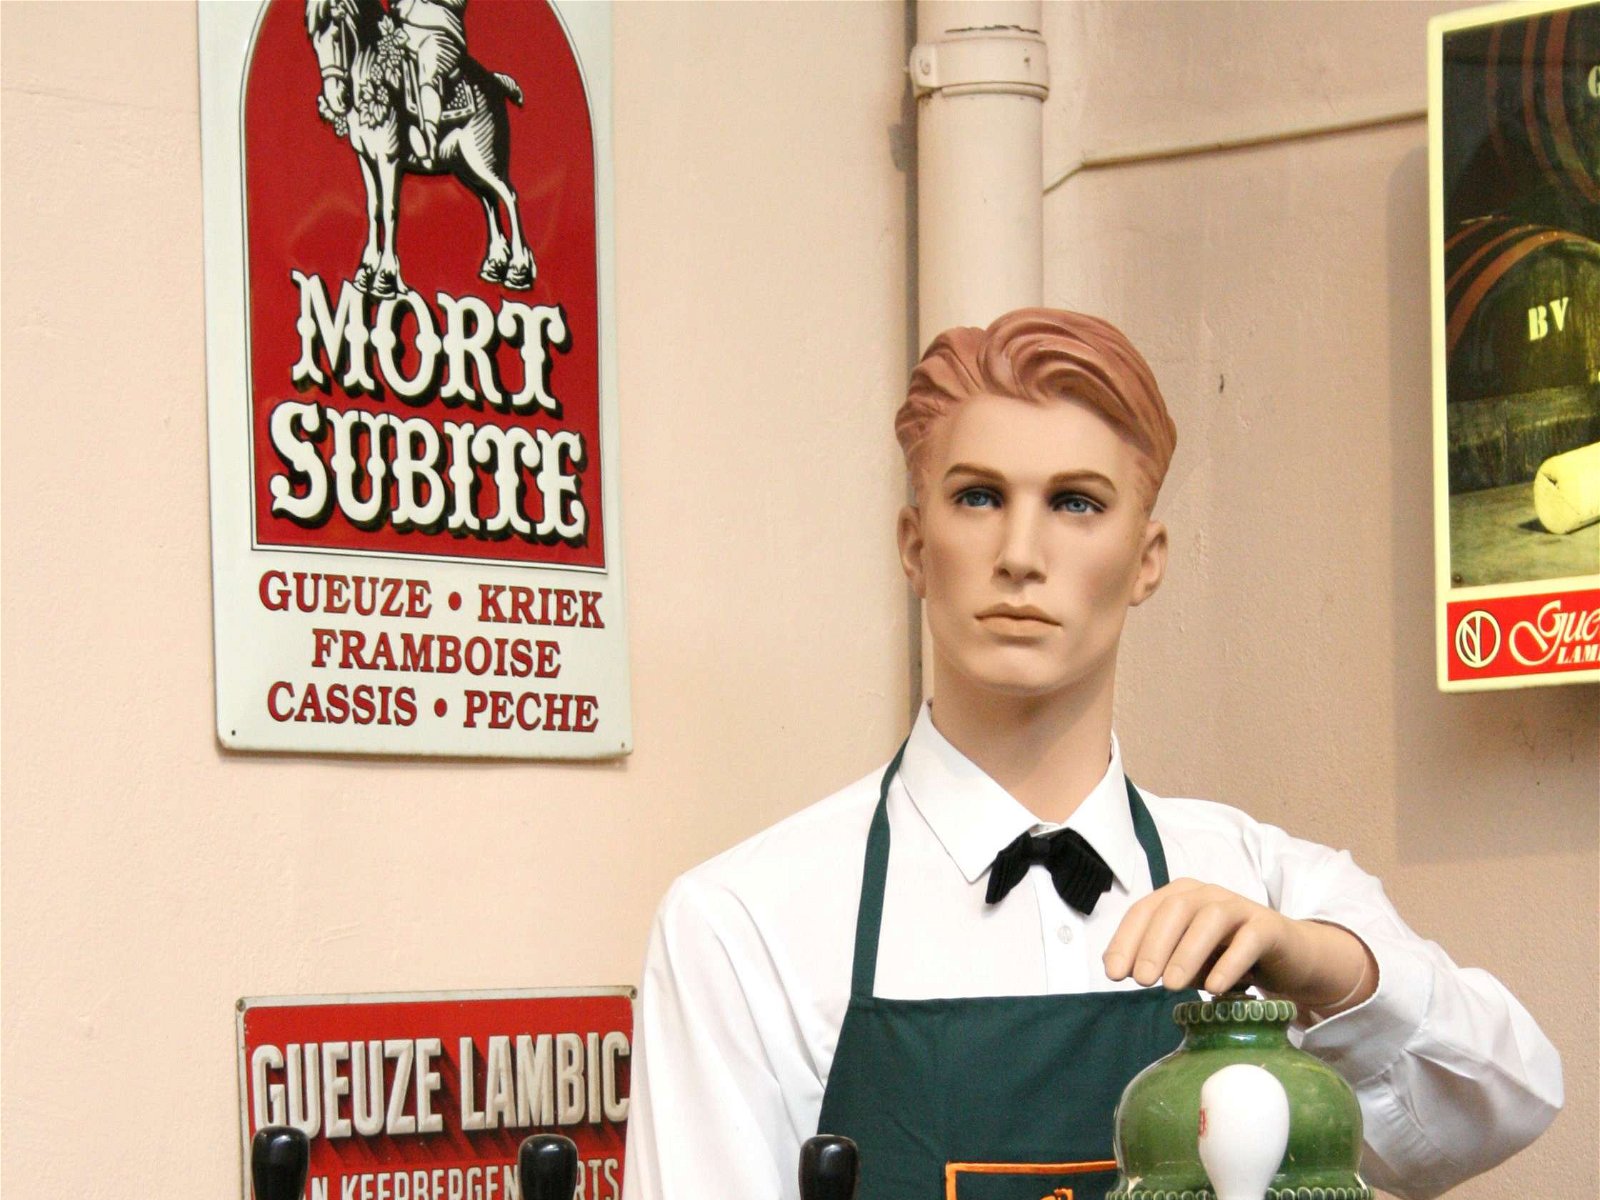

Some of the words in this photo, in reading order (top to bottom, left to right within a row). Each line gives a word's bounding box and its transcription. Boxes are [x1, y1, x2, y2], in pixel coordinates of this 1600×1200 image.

[290, 271, 572, 412] MORT
[1528, 296, 1569, 341] BV
[270, 401, 589, 544] SUBITE
[258, 570, 432, 619] GUEUZE
[478, 583, 605, 629] KRIEK
[311, 628, 562, 679] FRAMBOISE
[266, 681, 418, 727] CASSIS
[463, 689, 600, 734] PECHE
[251, 1037, 444, 1139] GUEUZE
[459, 1030, 631, 1131] LAMBIC
